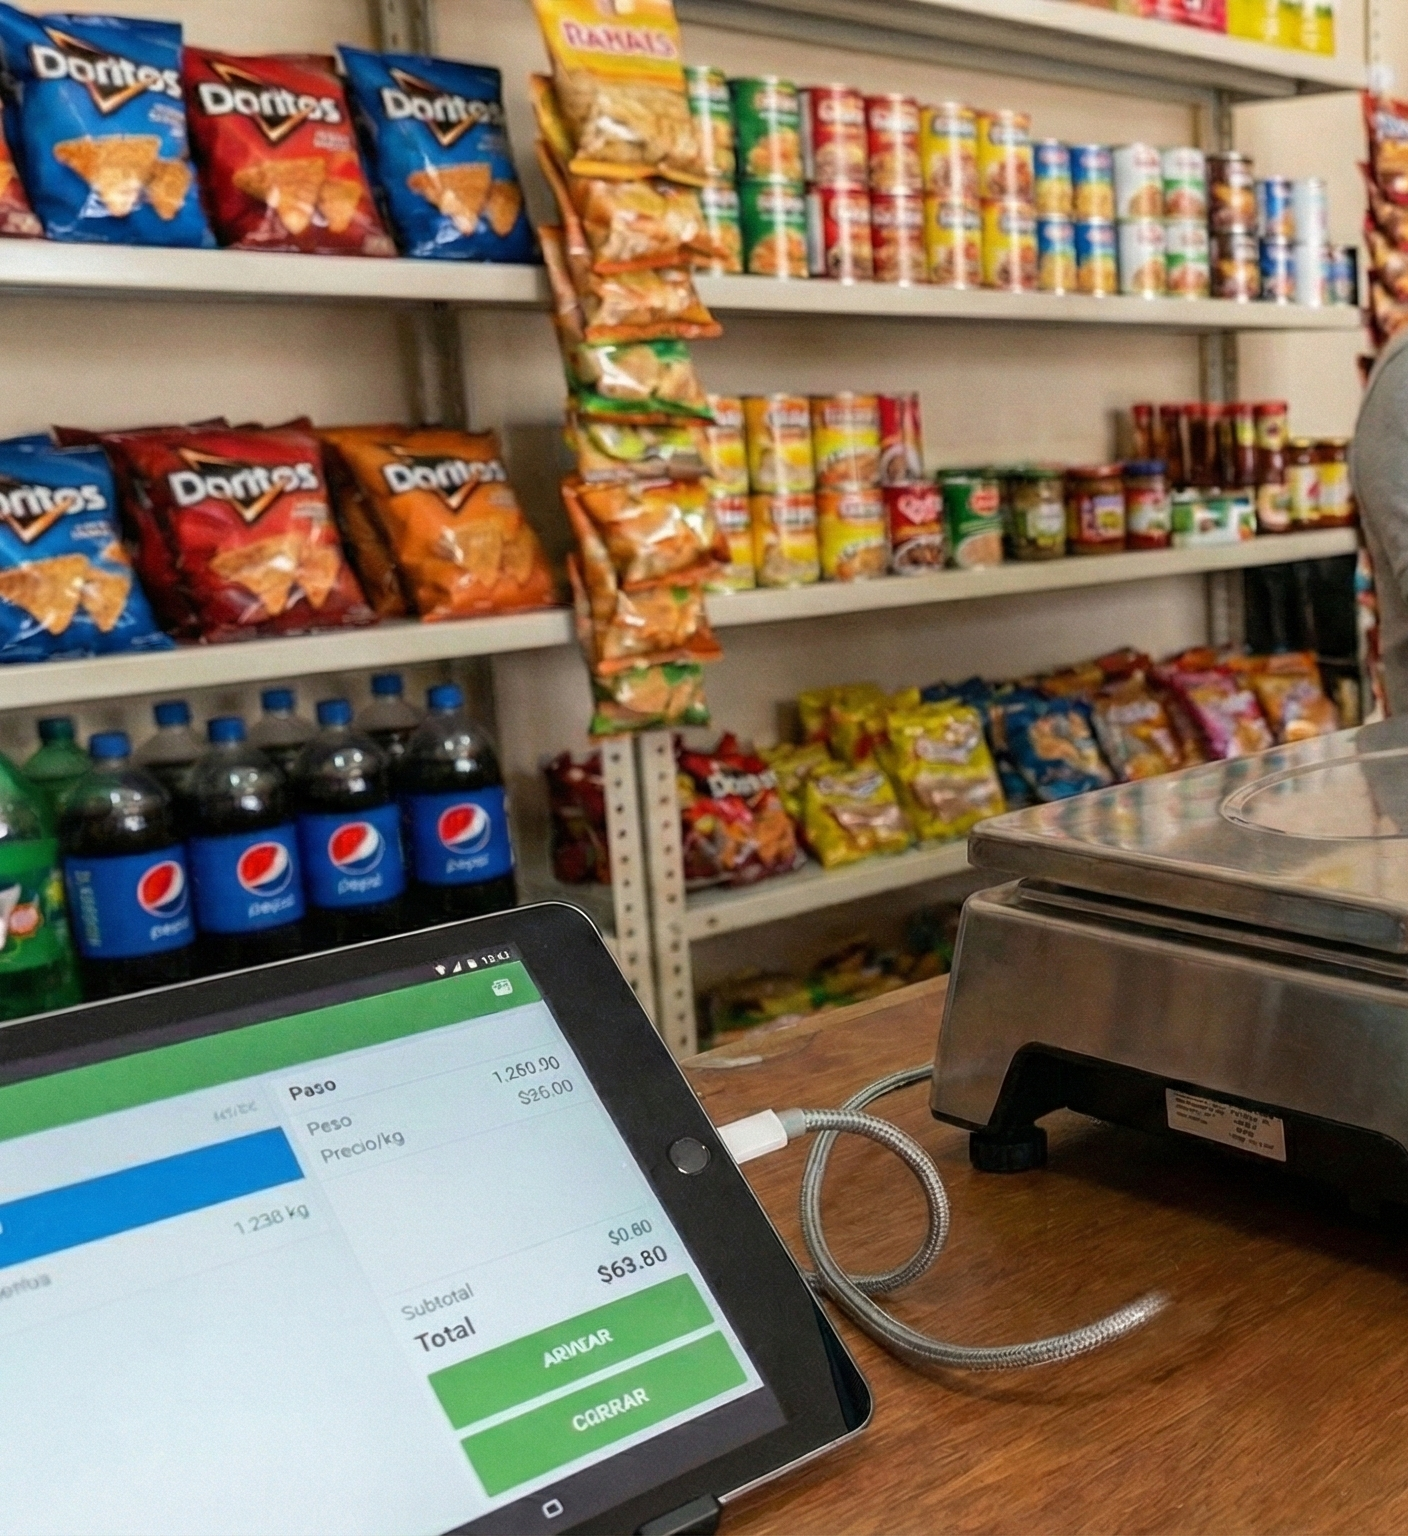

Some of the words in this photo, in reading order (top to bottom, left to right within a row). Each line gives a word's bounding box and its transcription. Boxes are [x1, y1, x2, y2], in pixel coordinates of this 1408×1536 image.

[31, 44, 183, 98] Doritos
[198, 82, 341, 123] Doritos
[381, 87, 504, 125] Doritos
[167, 463, 319, 507] Doritos
[382, 459, 507, 493] Doritos
[0, 484, 107, 517] ritos
[446, 853, 489, 874] pepsi
[338, 873, 382, 895] pepsi
[248, 896, 296, 919] pepsi
[150, 915, 190, 941] pepsi
[288, 1080, 337, 1101] Paso
[306, 1116, 352, 1137] Peso
[320, 1131, 405, 1163] Precio/kg
[401, 1282, 474, 1321] Subtotal
[414, 1315, 476, 1353] Total
[597, 1245, 668, 1285] $63.80
